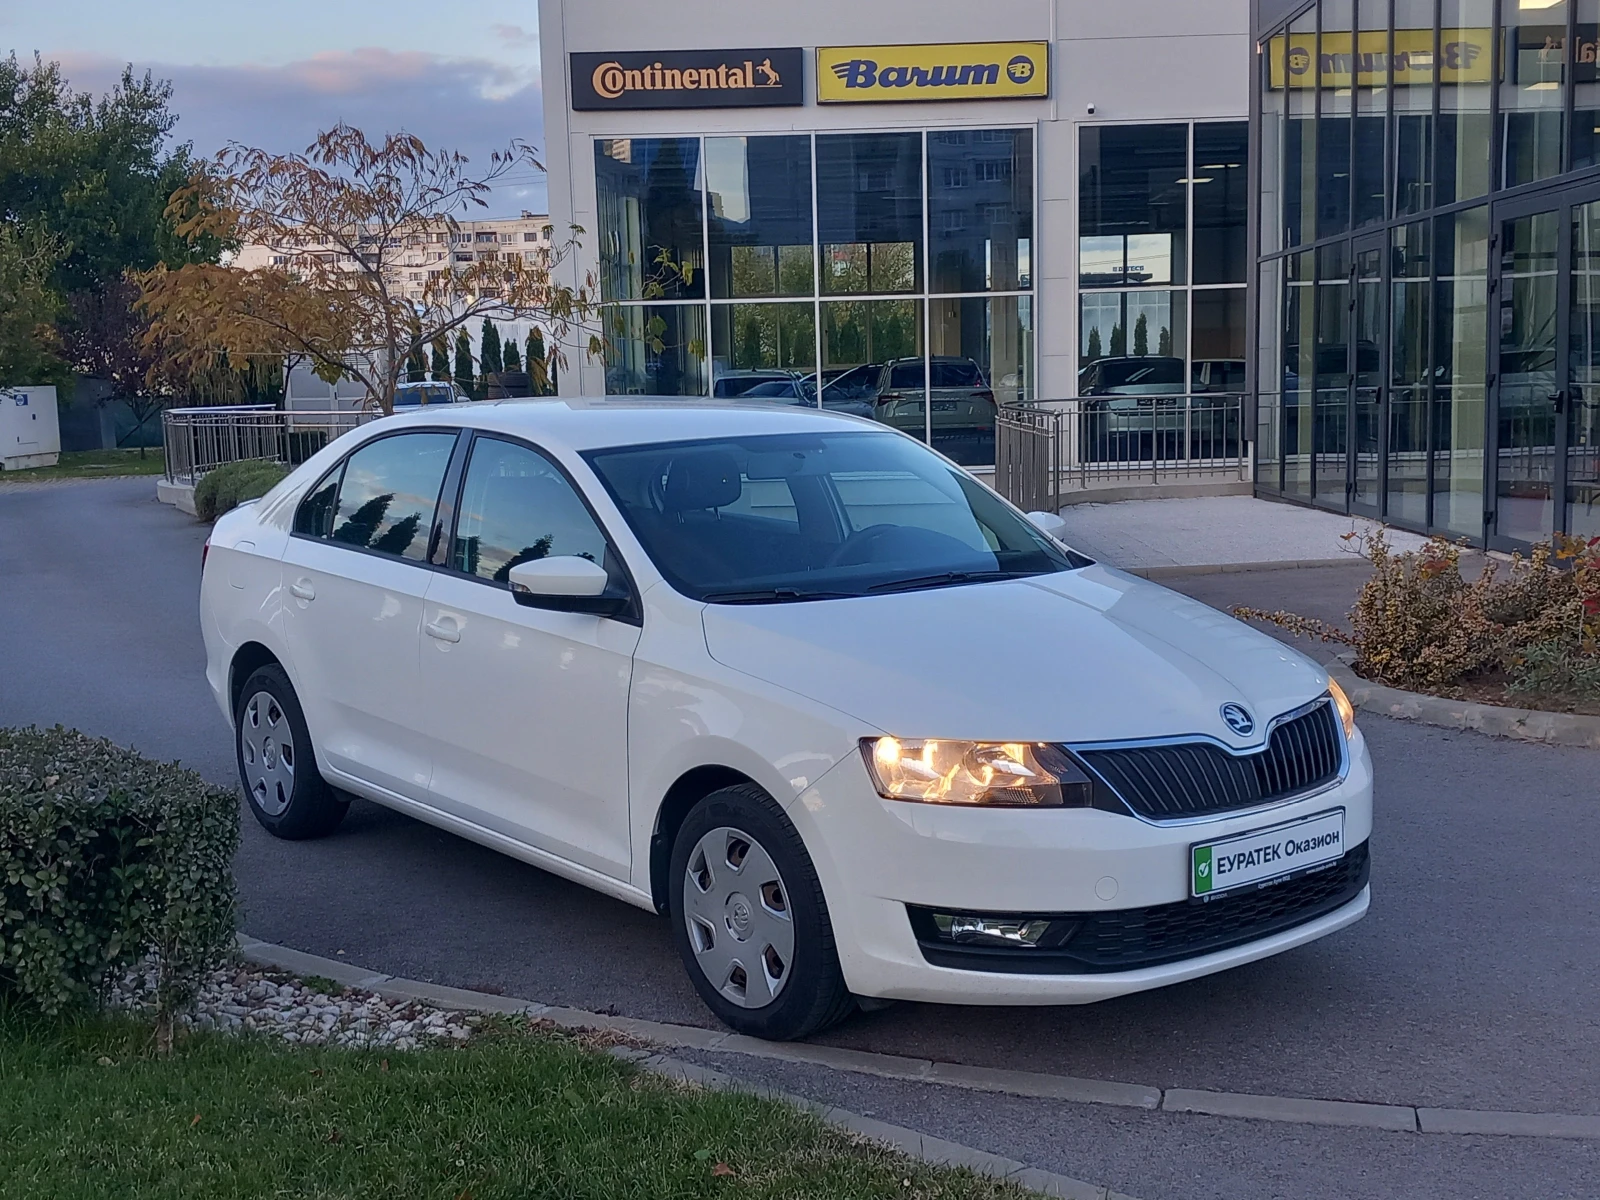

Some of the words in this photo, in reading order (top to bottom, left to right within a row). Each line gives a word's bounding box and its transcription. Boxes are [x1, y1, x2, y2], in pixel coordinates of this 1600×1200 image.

[592, 60, 755, 99] Continental
[831, 59, 999, 88] Barum
[1217, 843, 1282, 875] ЕУРАТЕК
[1285, 831, 1340, 857] Оказион
